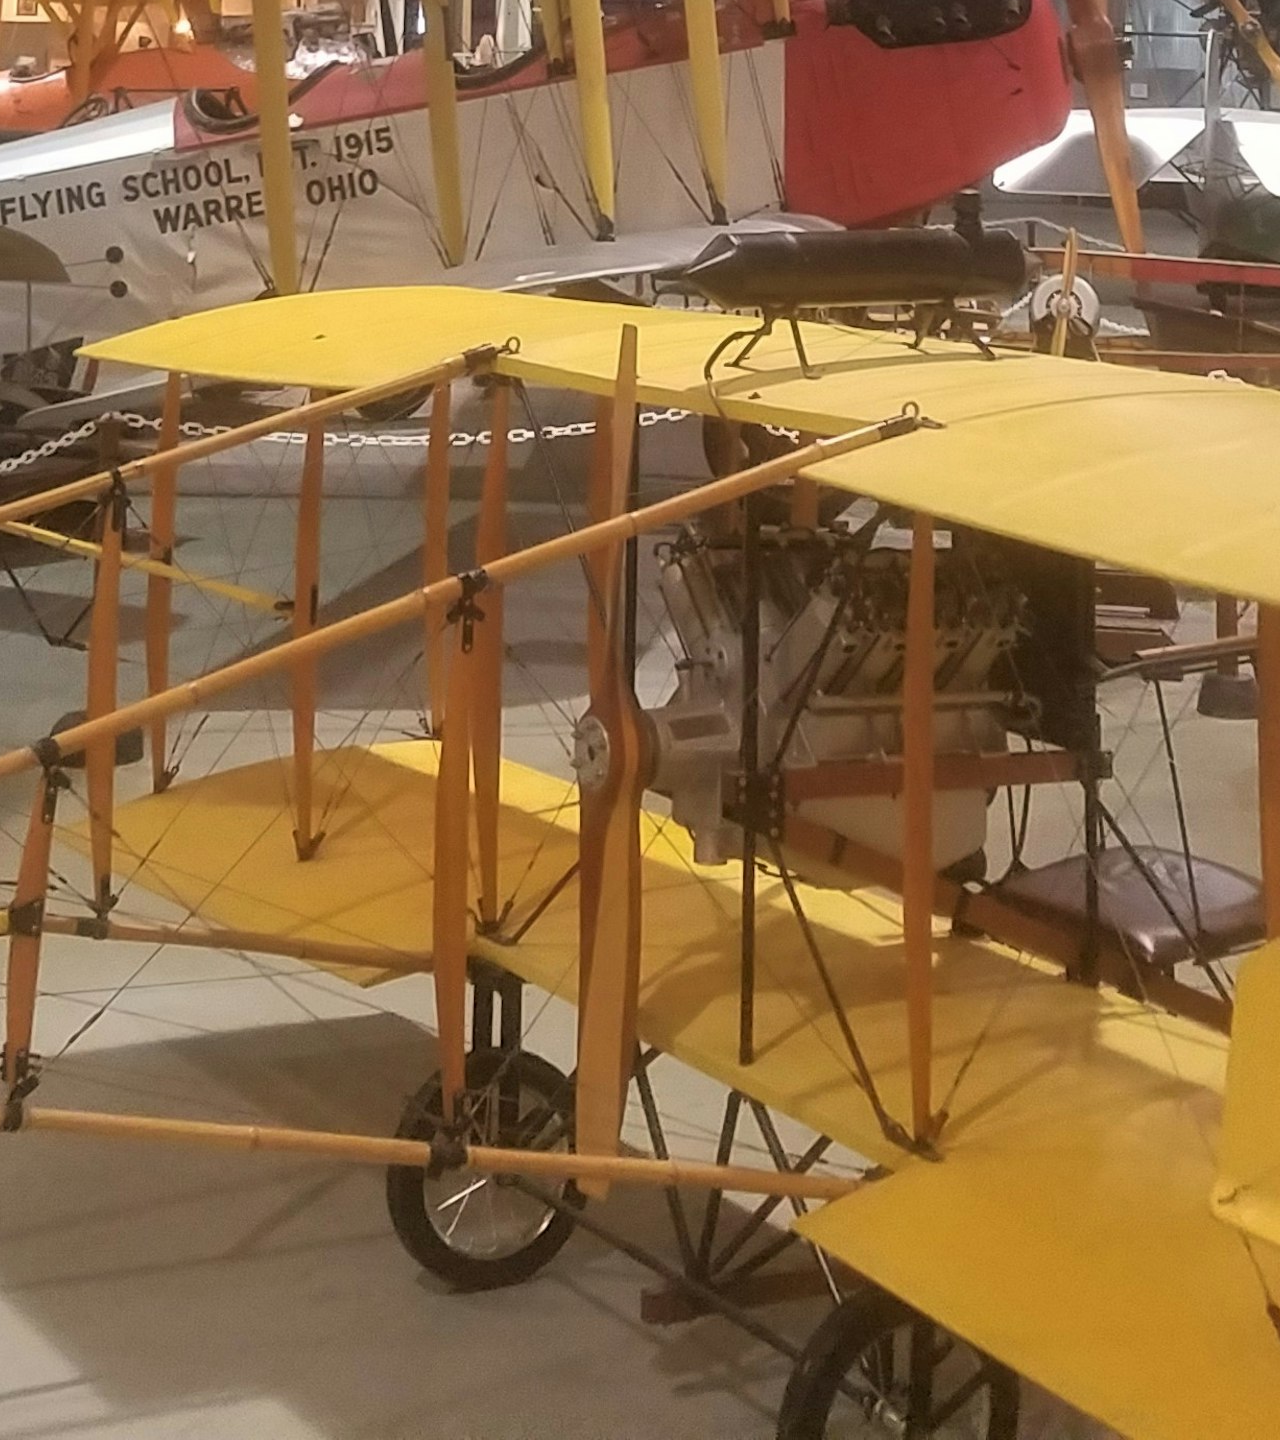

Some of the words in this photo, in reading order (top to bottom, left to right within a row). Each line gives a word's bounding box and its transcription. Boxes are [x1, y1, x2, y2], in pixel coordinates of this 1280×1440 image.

[0, 181, 106, 225] FLYING
[122, 158, 251, 202] SCHOOL,
[334, 126, 395, 162] 1915
[153, 190, 266, 234] WARRE
[305, 168, 380, 206] OHIO
